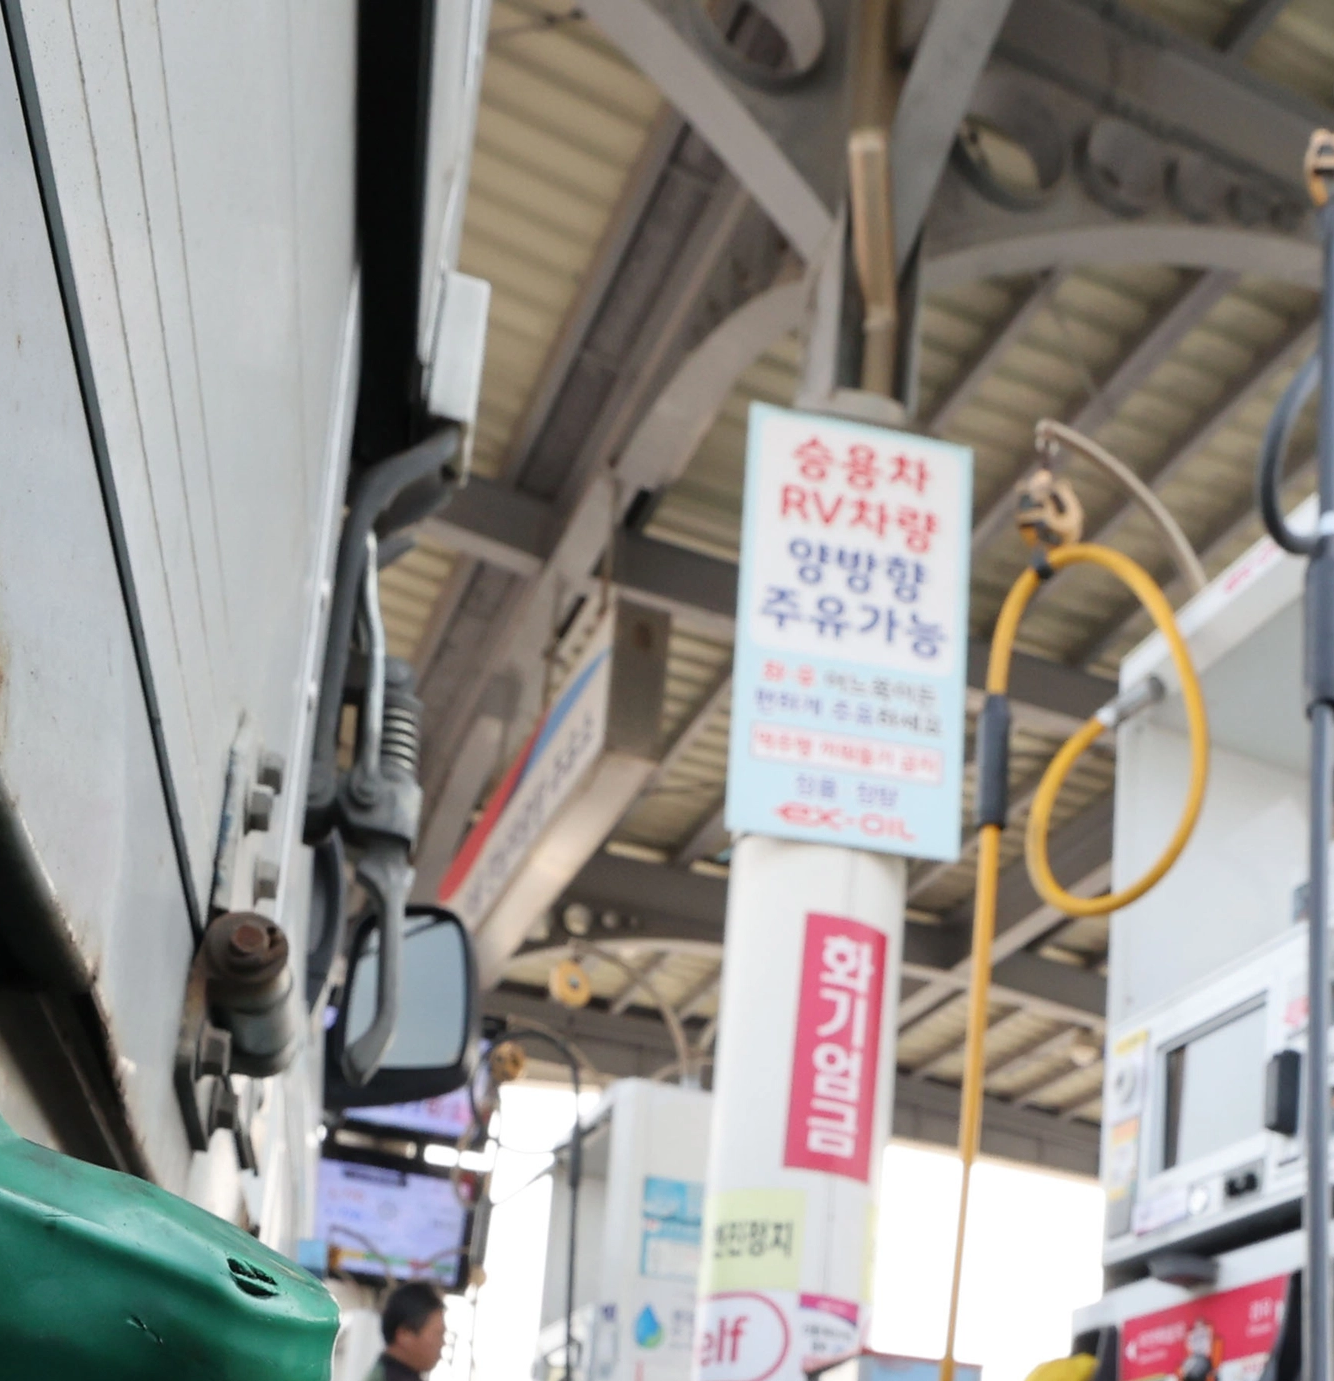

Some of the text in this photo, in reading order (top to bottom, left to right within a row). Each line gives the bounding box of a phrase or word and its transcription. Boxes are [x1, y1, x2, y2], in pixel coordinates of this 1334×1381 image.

[793, 437, 931, 497] 승용차
[779, 483, 937, 554] RV차량
[789, 536, 927, 602] 양방향
[760, 586, 946, 658] 주유가능
[805, 934, 875, 1160] 화기엄금
